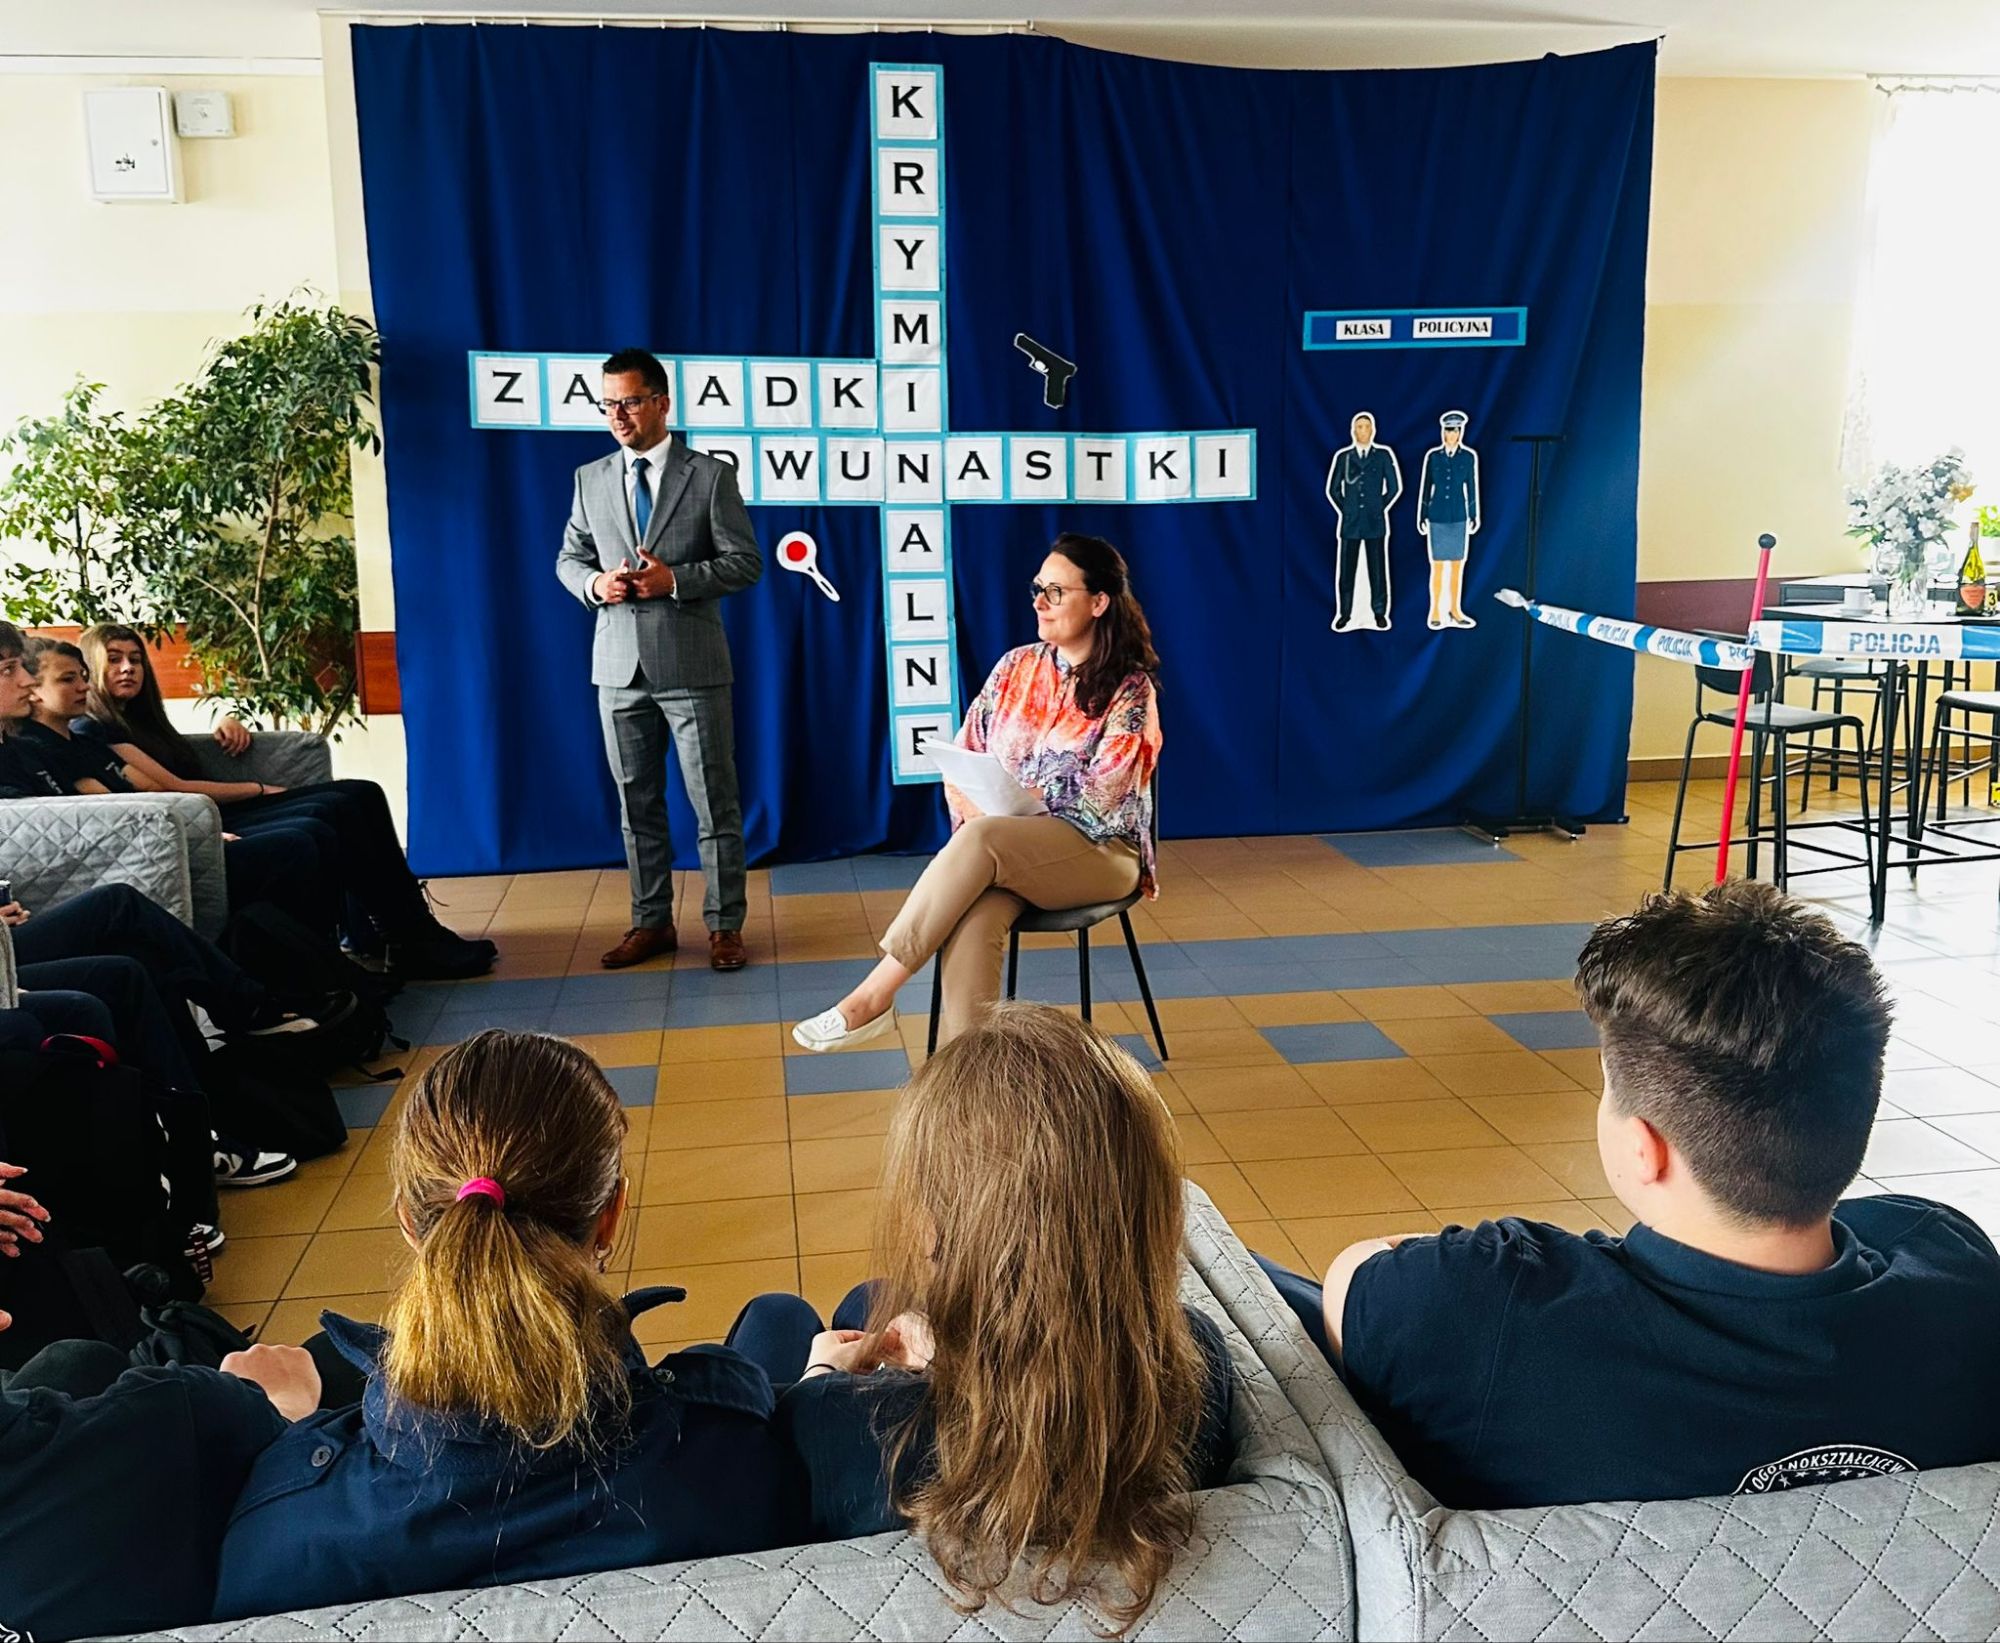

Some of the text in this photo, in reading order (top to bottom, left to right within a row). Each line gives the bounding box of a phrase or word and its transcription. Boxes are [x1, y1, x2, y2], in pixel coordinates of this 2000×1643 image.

[1343, 320, 1489, 336] KLASA POLICYJNA
[491, 370, 917, 413] ZAADKI
[890, 85, 939, 756] KRYMINALNE
[1988, 592, 1996, 606] 3
[1657, 635, 1693, 657] POLICJA
[1849, 632, 1941, 655] POLICJA
